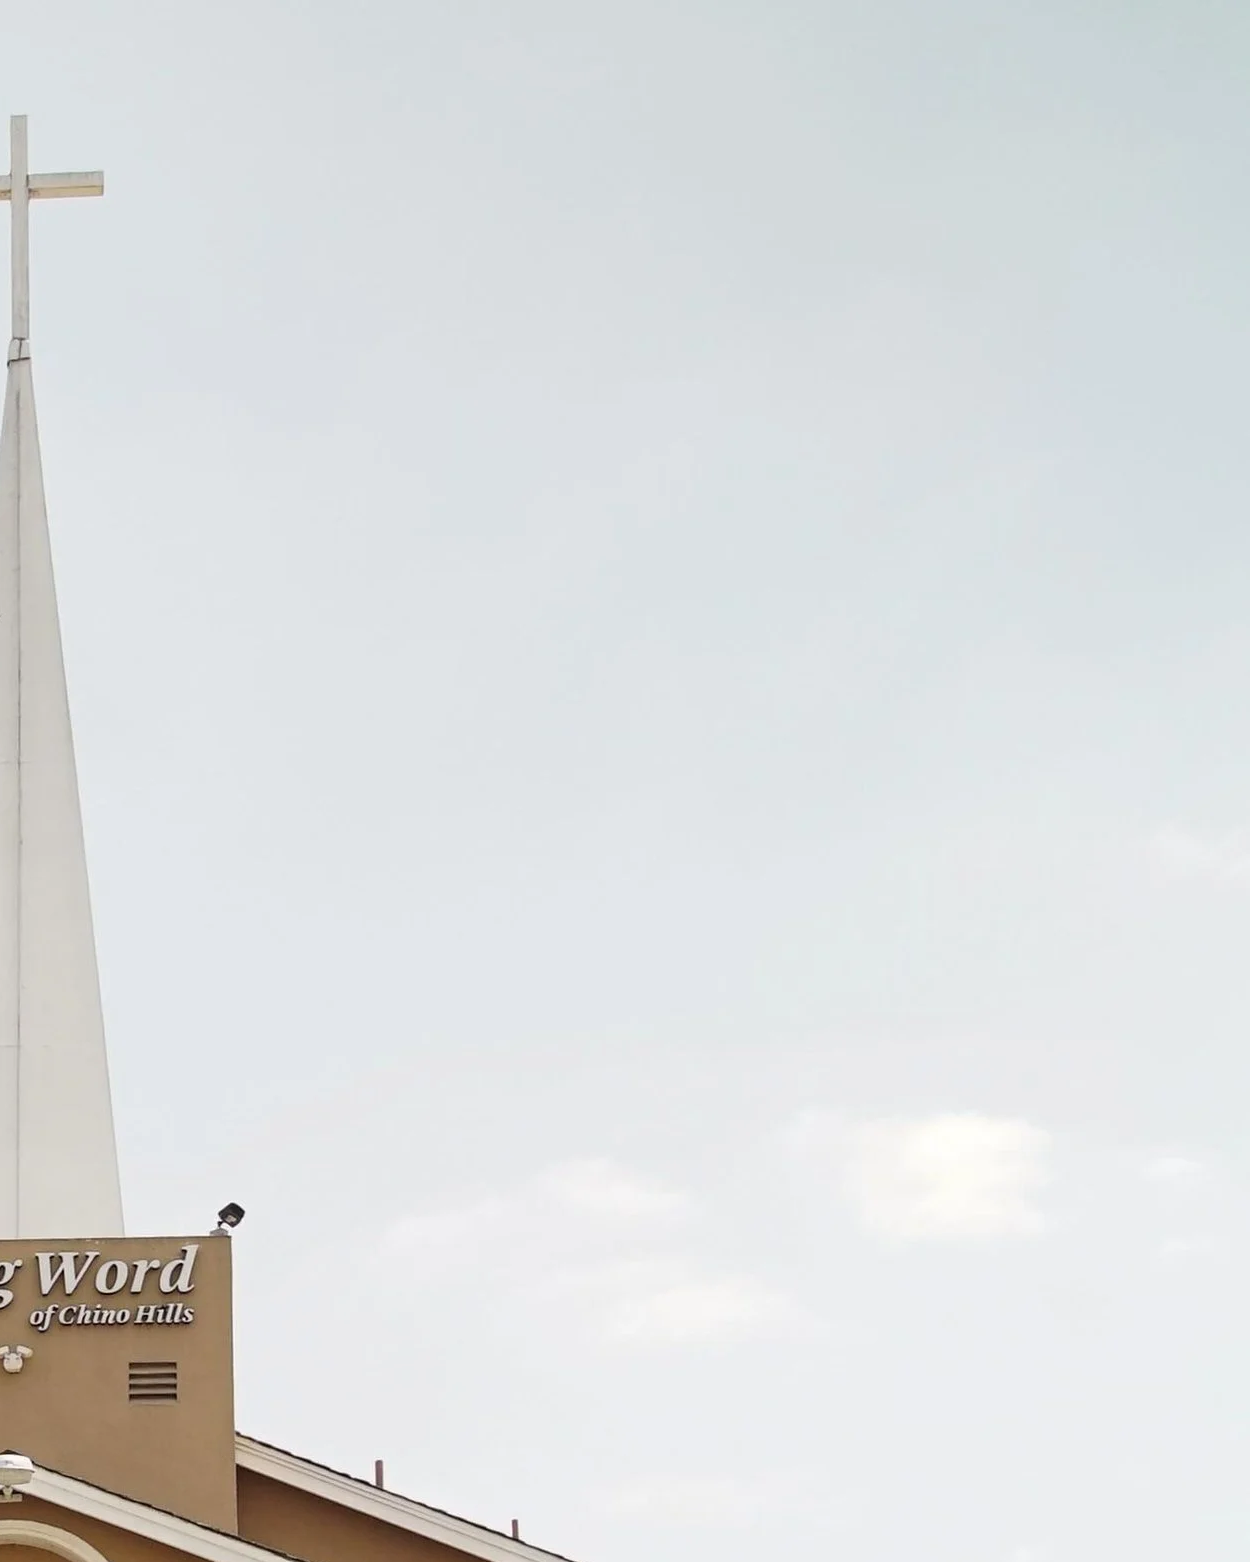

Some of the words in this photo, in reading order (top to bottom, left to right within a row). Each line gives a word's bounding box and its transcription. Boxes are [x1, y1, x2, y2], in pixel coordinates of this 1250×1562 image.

[35, 1244, 199, 1296] Word
[29, 1303, 59, 1333] of
[58, 1303, 131, 1326] Chino
[134, 1302, 195, 1325] Hills
